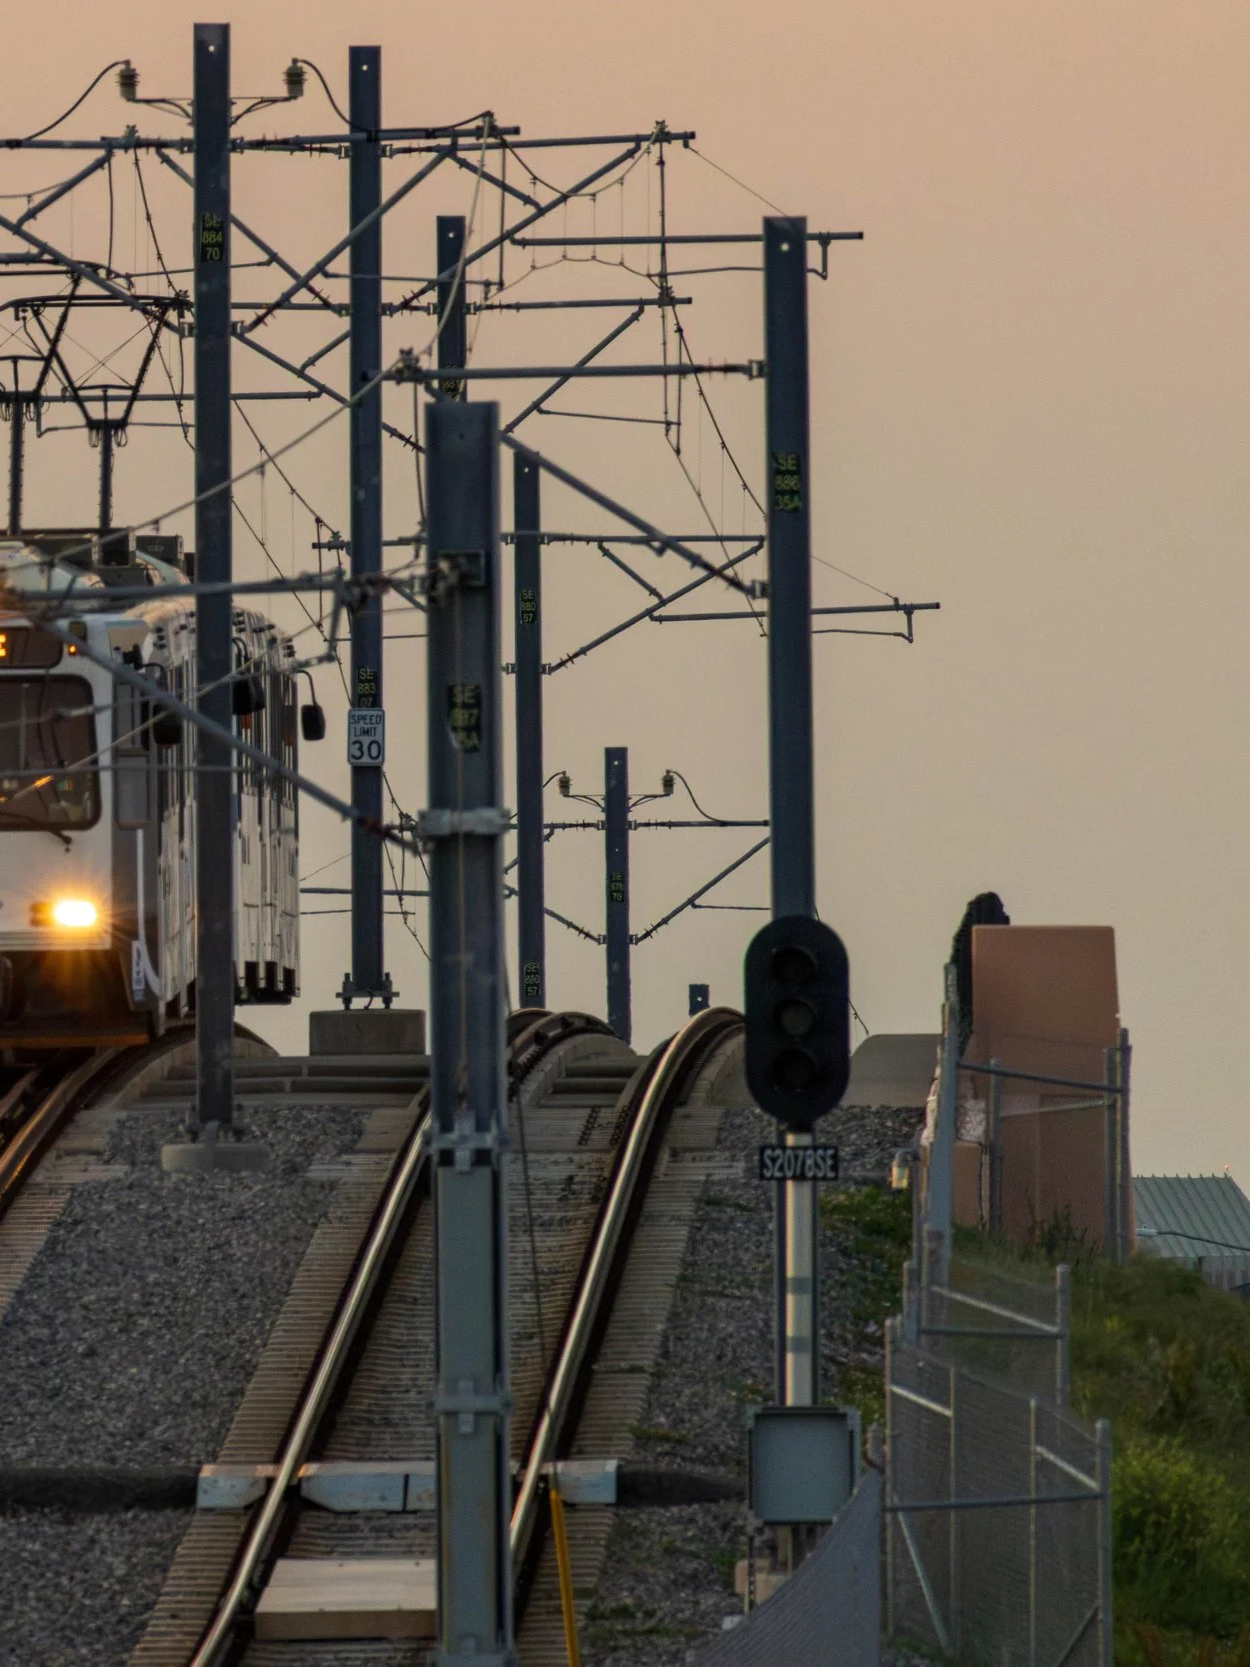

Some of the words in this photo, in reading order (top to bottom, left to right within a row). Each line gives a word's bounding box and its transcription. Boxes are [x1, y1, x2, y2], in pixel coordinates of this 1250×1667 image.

[206, 247, 220, 260] 70
[359, 668, 374, 680] SE
[350, 714, 382, 725] SPEED
[354, 727, 378, 737] LIMIT
[351, 740, 382, 760] 30
[763, 1148, 835, 1178] S2078SE
